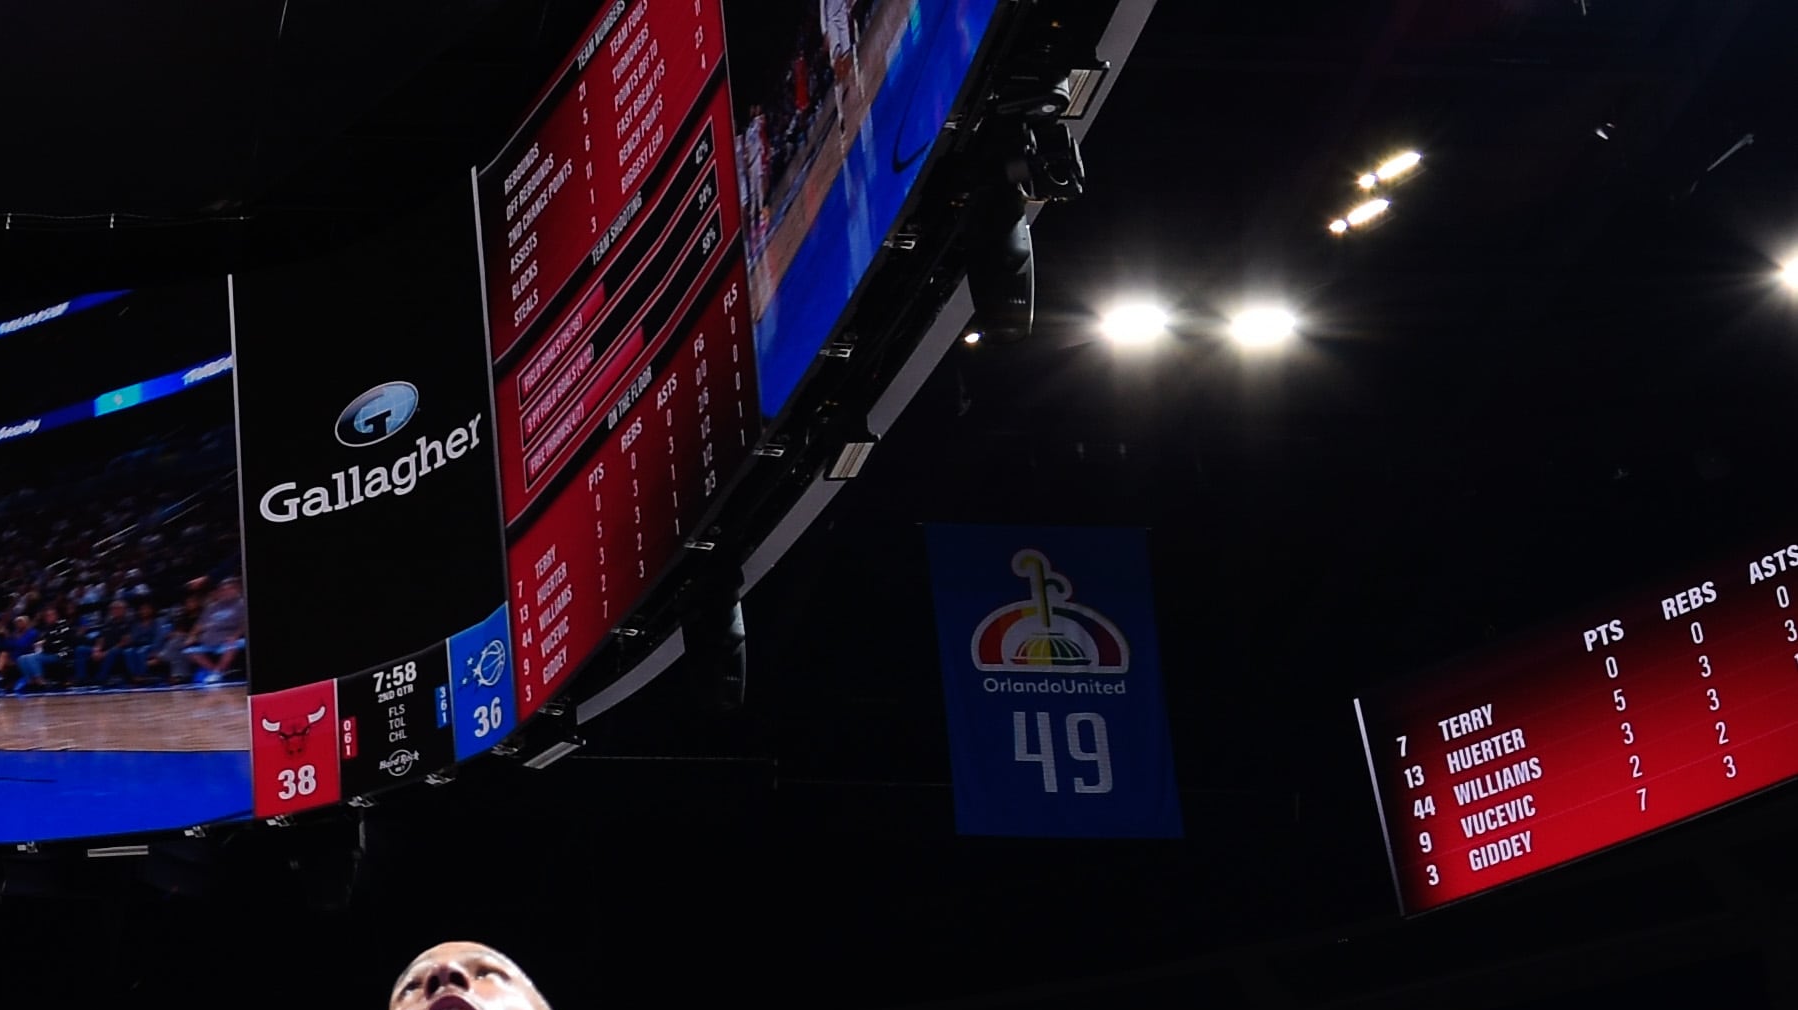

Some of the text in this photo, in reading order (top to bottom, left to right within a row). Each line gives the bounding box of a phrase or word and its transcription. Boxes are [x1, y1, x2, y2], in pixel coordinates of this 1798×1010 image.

[504, 142, 540, 196] REBOUNDS
[591, 191, 642, 266] TEAM SHOOTING
[510, 231, 538, 275] ASSISTS
[511, 260, 538, 302] BLOCKS
[514, 288, 539, 327] STEALS
[588, 282, 738, 491] PTS REBS ASTS FG FLS
[259, 413, 481, 522] Gallagher
[534, 545, 556, 581] TERRY
[536, 561, 567, 607] HUERTER
[1583, 544, 1798, 652] PTS REBS ASTS
[538, 584, 573, 633] WILLIAMS
[541, 615, 570, 658] VUCEVIC
[372, 661, 418, 693] 7:58
[542, 645, 567, 685] GIDDEY
[1396, 585, 1790, 757] 7 TERRY 0 0 0
[377, 683, 414, 704] 2ND QTR
[439, 686, 447, 699] 3
[440, 700, 448, 711] 6
[983, 677, 1126, 695] OrlandoUnited
[1404, 619, 1798, 789] 13 HUERTER 5 3 3
[343, 720, 351, 731] 0
[388, 704, 406, 718] FLS
[388, 717, 406, 731] TOL
[441, 712, 447, 724] 1
[473, 696, 502, 738] 36
[344, 732, 352, 744] 6
[345, 745, 351, 756] 1
[389, 729, 408, 743] CHL
[1013, 711, 1113, 794] 49
[1413, 688, 1721, 820] 44 WILLIAMS 3 3
[379, 755, 400, 771] Hard
[400, 750, 420, 766] Rock
[277, 764, 316, 800] 38
[1418, 721, 1729, 853] 9 VUCEVIC 2 2
[1425, 755, 1737, 886] 3 GIDDEY 7 3
